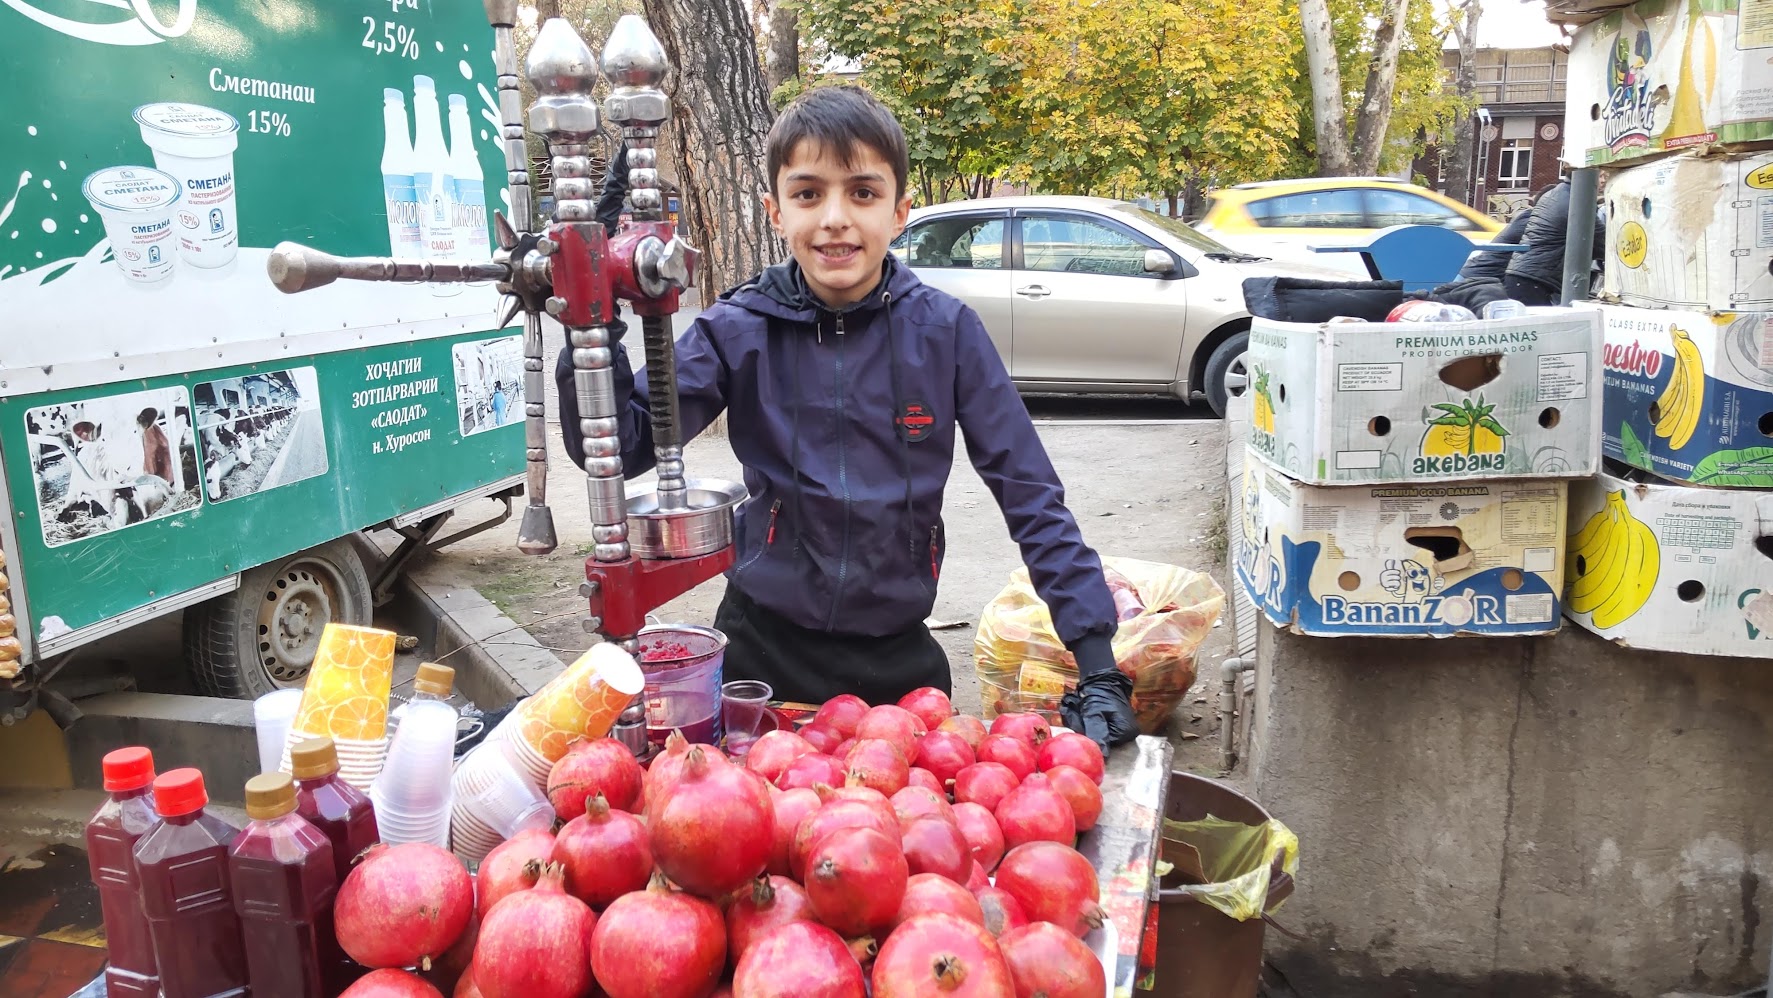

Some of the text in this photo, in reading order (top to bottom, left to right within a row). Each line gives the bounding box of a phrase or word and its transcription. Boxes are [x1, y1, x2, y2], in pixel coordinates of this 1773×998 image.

[361, 16, 420, 60] 2,5%
[208, 67, 316, 104] Сметанаи
[247, 109, 291, 137] 15%
[187, 171, 232, 190] СМЕТАНА
[104, 184, 169, 196] СМЕТАНА
[133, 195, 158, 203] 15%
[131, 218, 171, 234] СМЕТАНА
[179, 213, 198, 227] 15%
[431, 240, 455, 251] САОДАТ
[124, 250, 139, 260] 15%
[1609, 318, 1664, 333] CLASS EXTRA
[1395, 330, 1538, 348] PREMIUM BANANAS
[1402, 350, 1458, 358] PRODUCT
[1478, 344, 1534, 355] ECUADOR
[1603, 338, 1662, 377] aestro
[1603, 376, 1656, 396] MIUM BANANAS
[371, 404, 428, 429] «САОДАТ»
[372, 429, 431, 454] н. Хуросон
[1639, 451, 1695, 472] CAVENDISH VARIETY
[1371, 486, 1489, 498] PREMIUM GOLD BANANA
